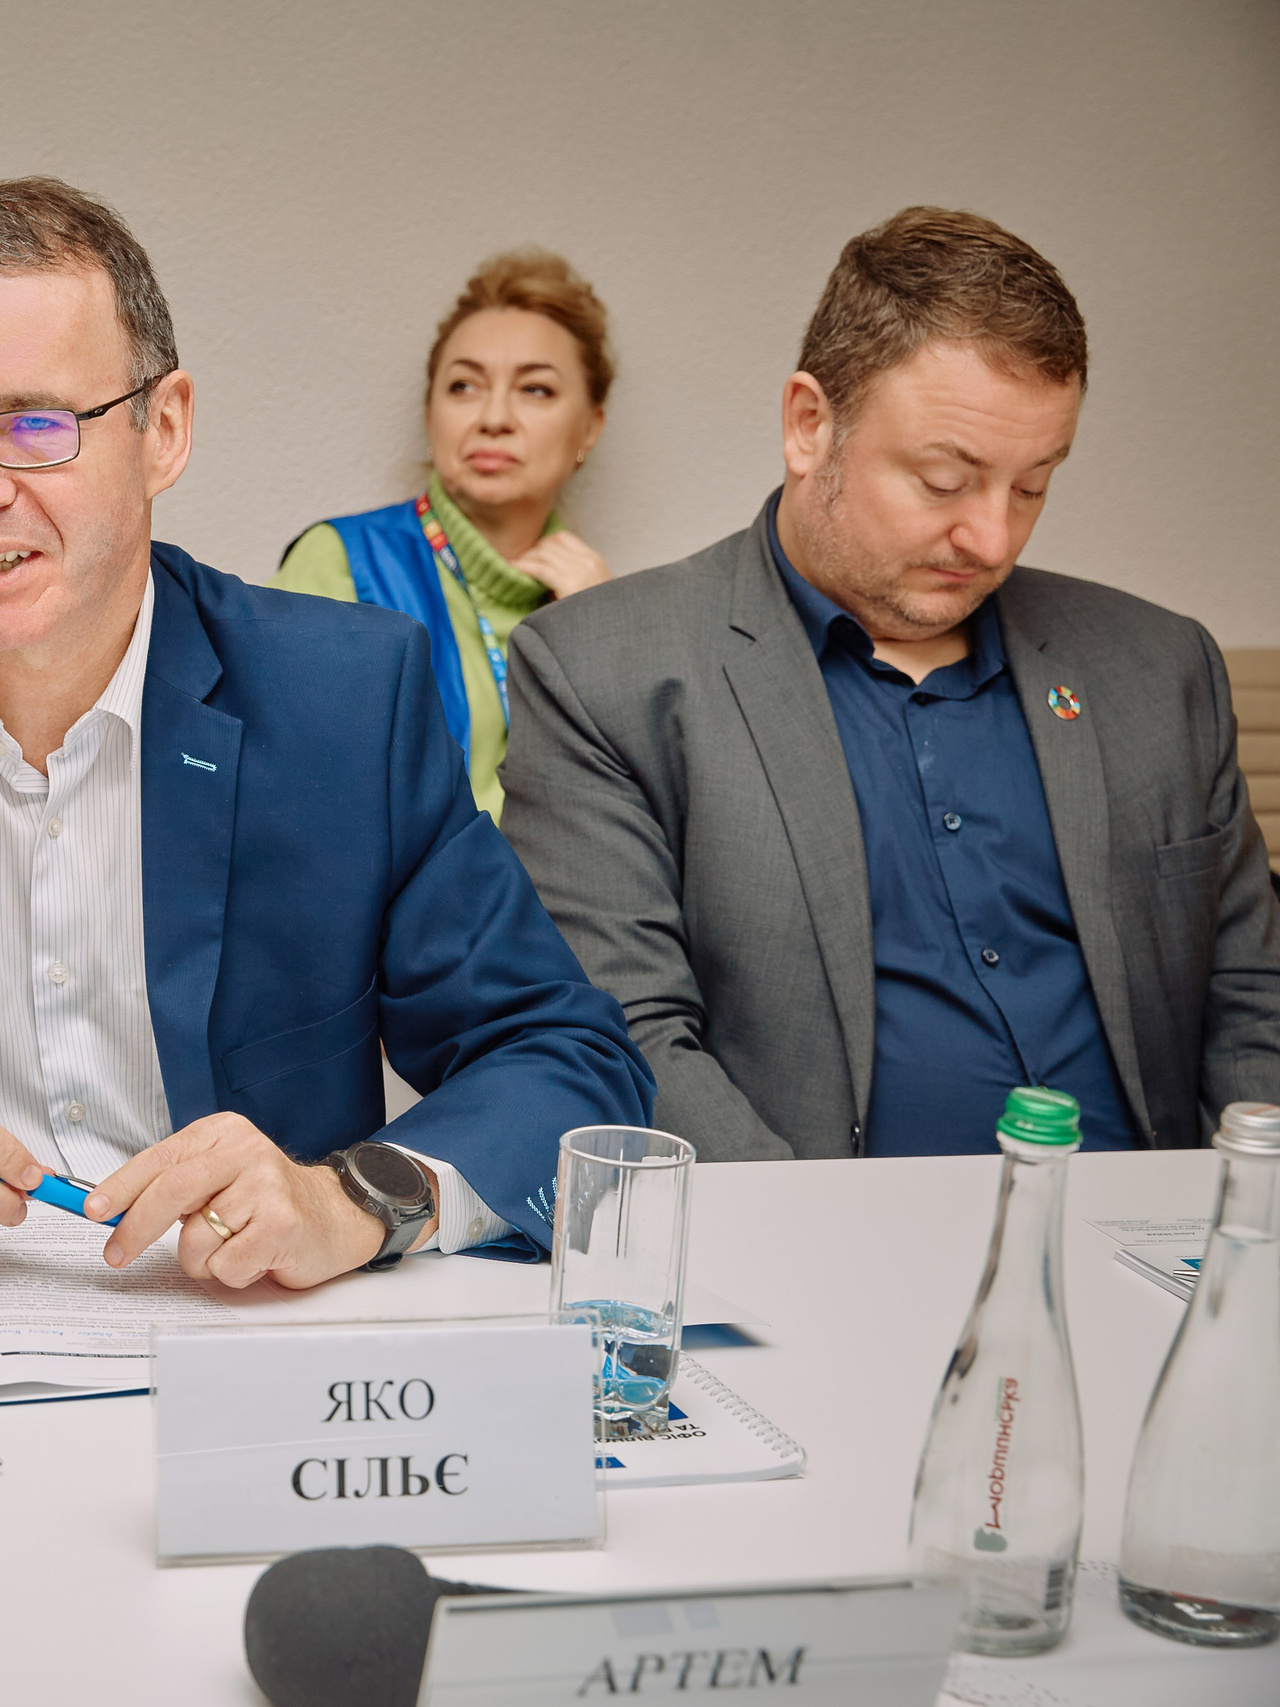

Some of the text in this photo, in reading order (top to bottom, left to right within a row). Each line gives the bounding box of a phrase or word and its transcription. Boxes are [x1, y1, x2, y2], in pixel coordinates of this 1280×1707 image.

[319, 1378, 436, 1423] ЯКО
[291, 1453, 469, 1501] СІЛЬЄ
[576, 1646, 808, 1697] АРТЕМ
